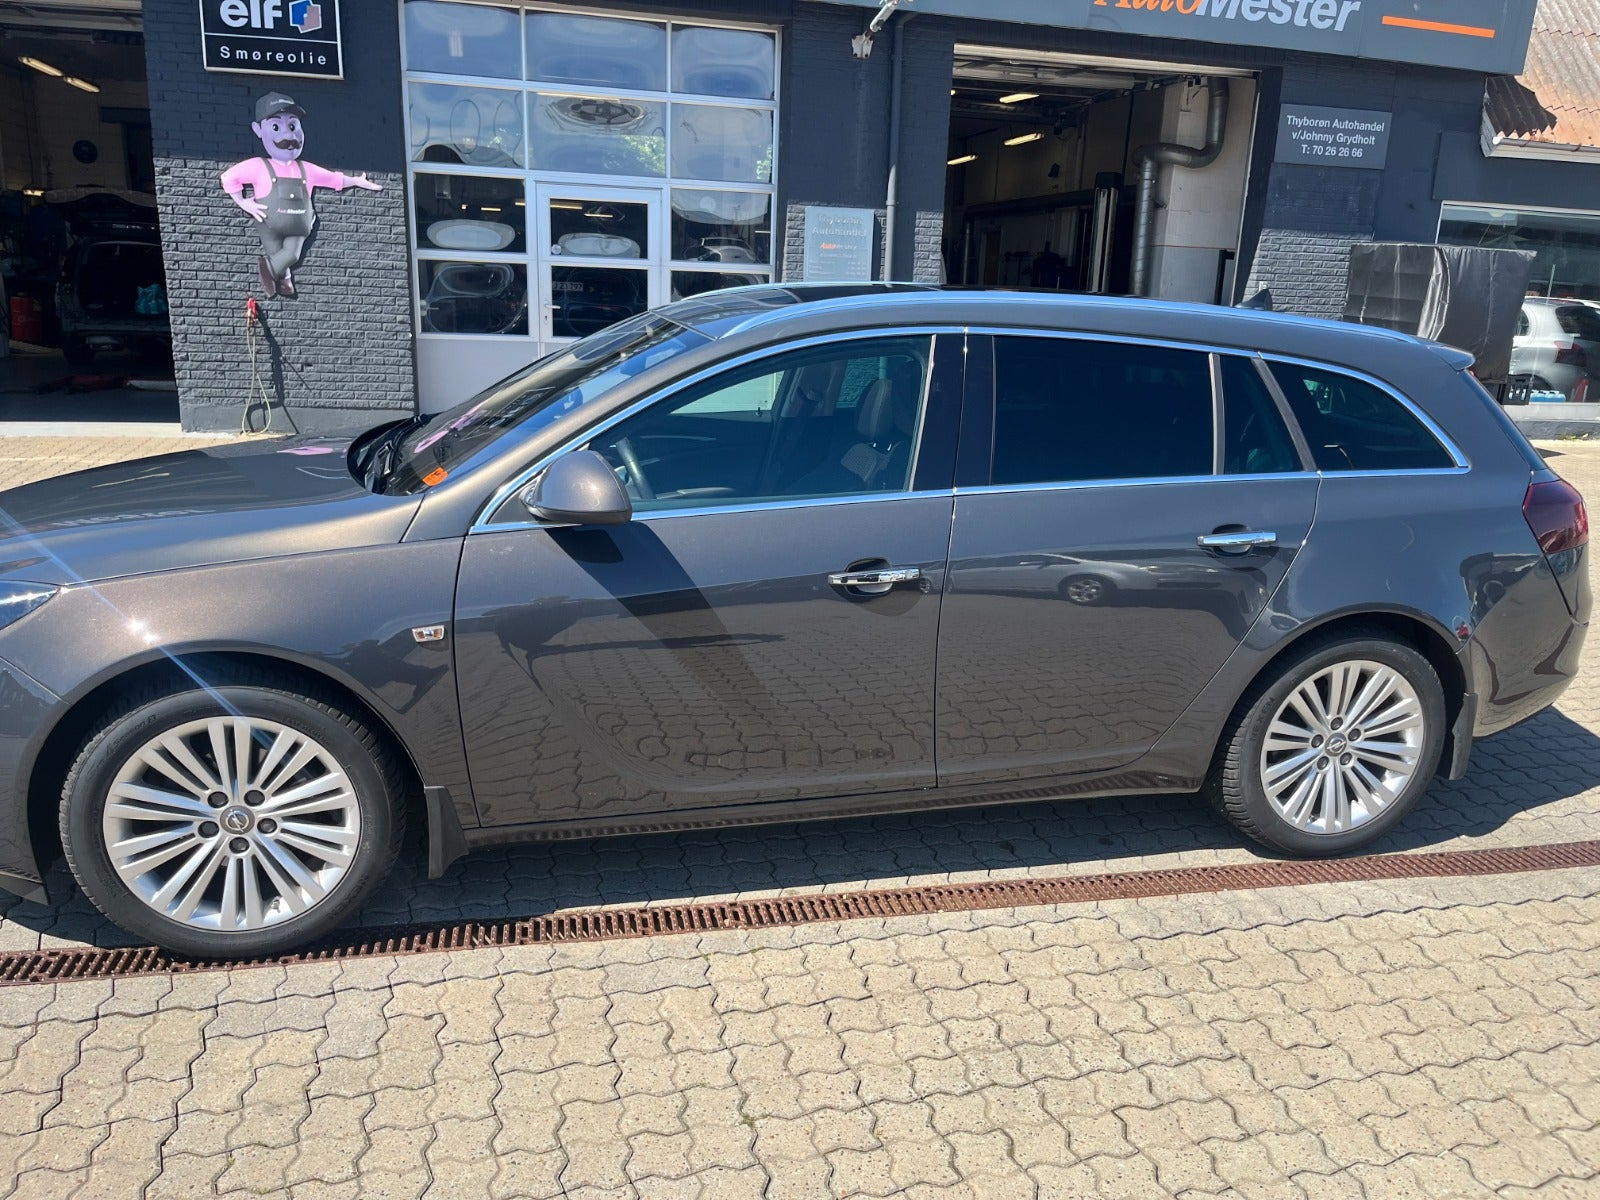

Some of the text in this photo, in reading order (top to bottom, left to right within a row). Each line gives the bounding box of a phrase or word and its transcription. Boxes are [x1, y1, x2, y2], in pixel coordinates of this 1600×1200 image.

[220, 0, 282, 29] elf
[1093, 0, 1361, 32] Mester
[220, 46, 326, 65] Smøreolie
[1332, 119, 1385, 132] Autohandel
[1291, 130, 1375, 145] v/Johnny Grydholt
[1301, 144, 1363, 157] T: 70 26 26 66
